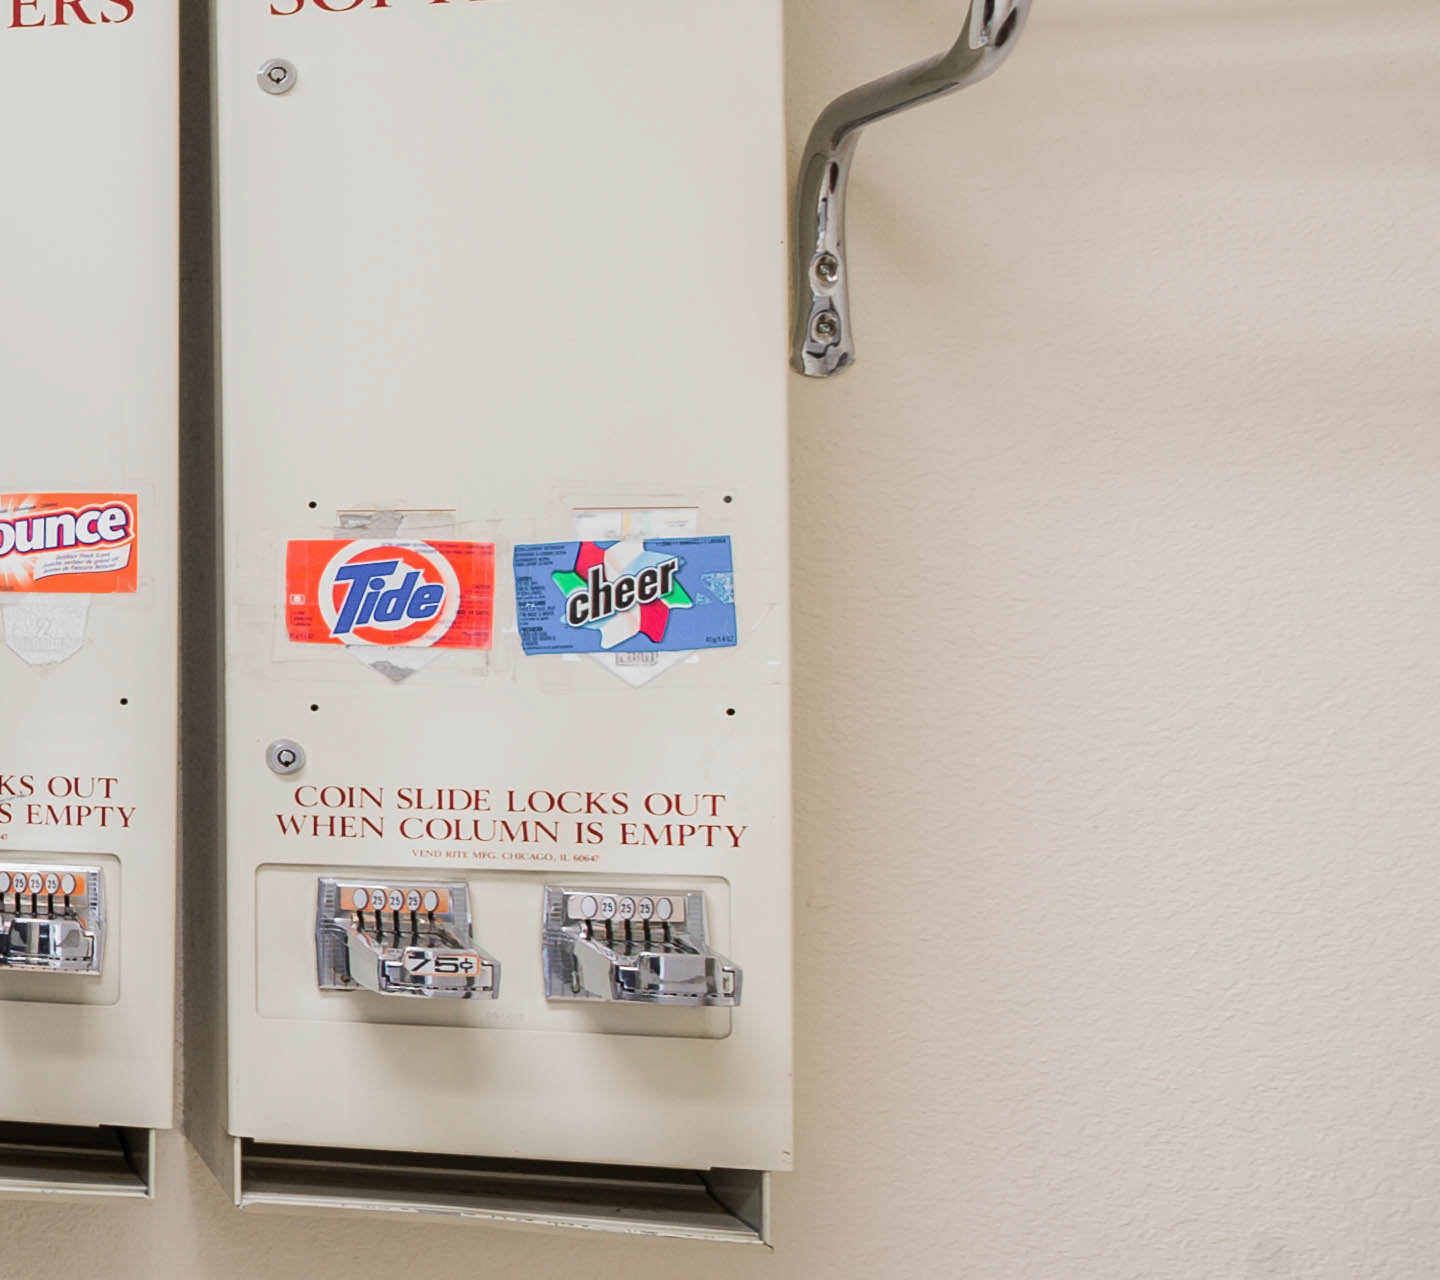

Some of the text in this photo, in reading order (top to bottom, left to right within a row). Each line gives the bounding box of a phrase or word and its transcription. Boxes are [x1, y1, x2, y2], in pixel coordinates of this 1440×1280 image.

[333, 560, 444, 634] Tide
[568, 559, 677, 626] cheer
[47, 776, 118, 799] OUT
[294, 785, 727, 817] COIN SLIDE LOCKS OUT
[26, 803, 136, 829] EMPTY
[276, 813, 749, 848] WHEN COLUMN IS EMPTY
[412, 850, 442, 858] VEND
[445, 850, 468, 858] RITE
[501, 852, 556, 862] CHICAGO,
[373, 895, 383, 905] 25
[603, 902, 613, 912] 25
[407, 951, 475, 973] 75¢
